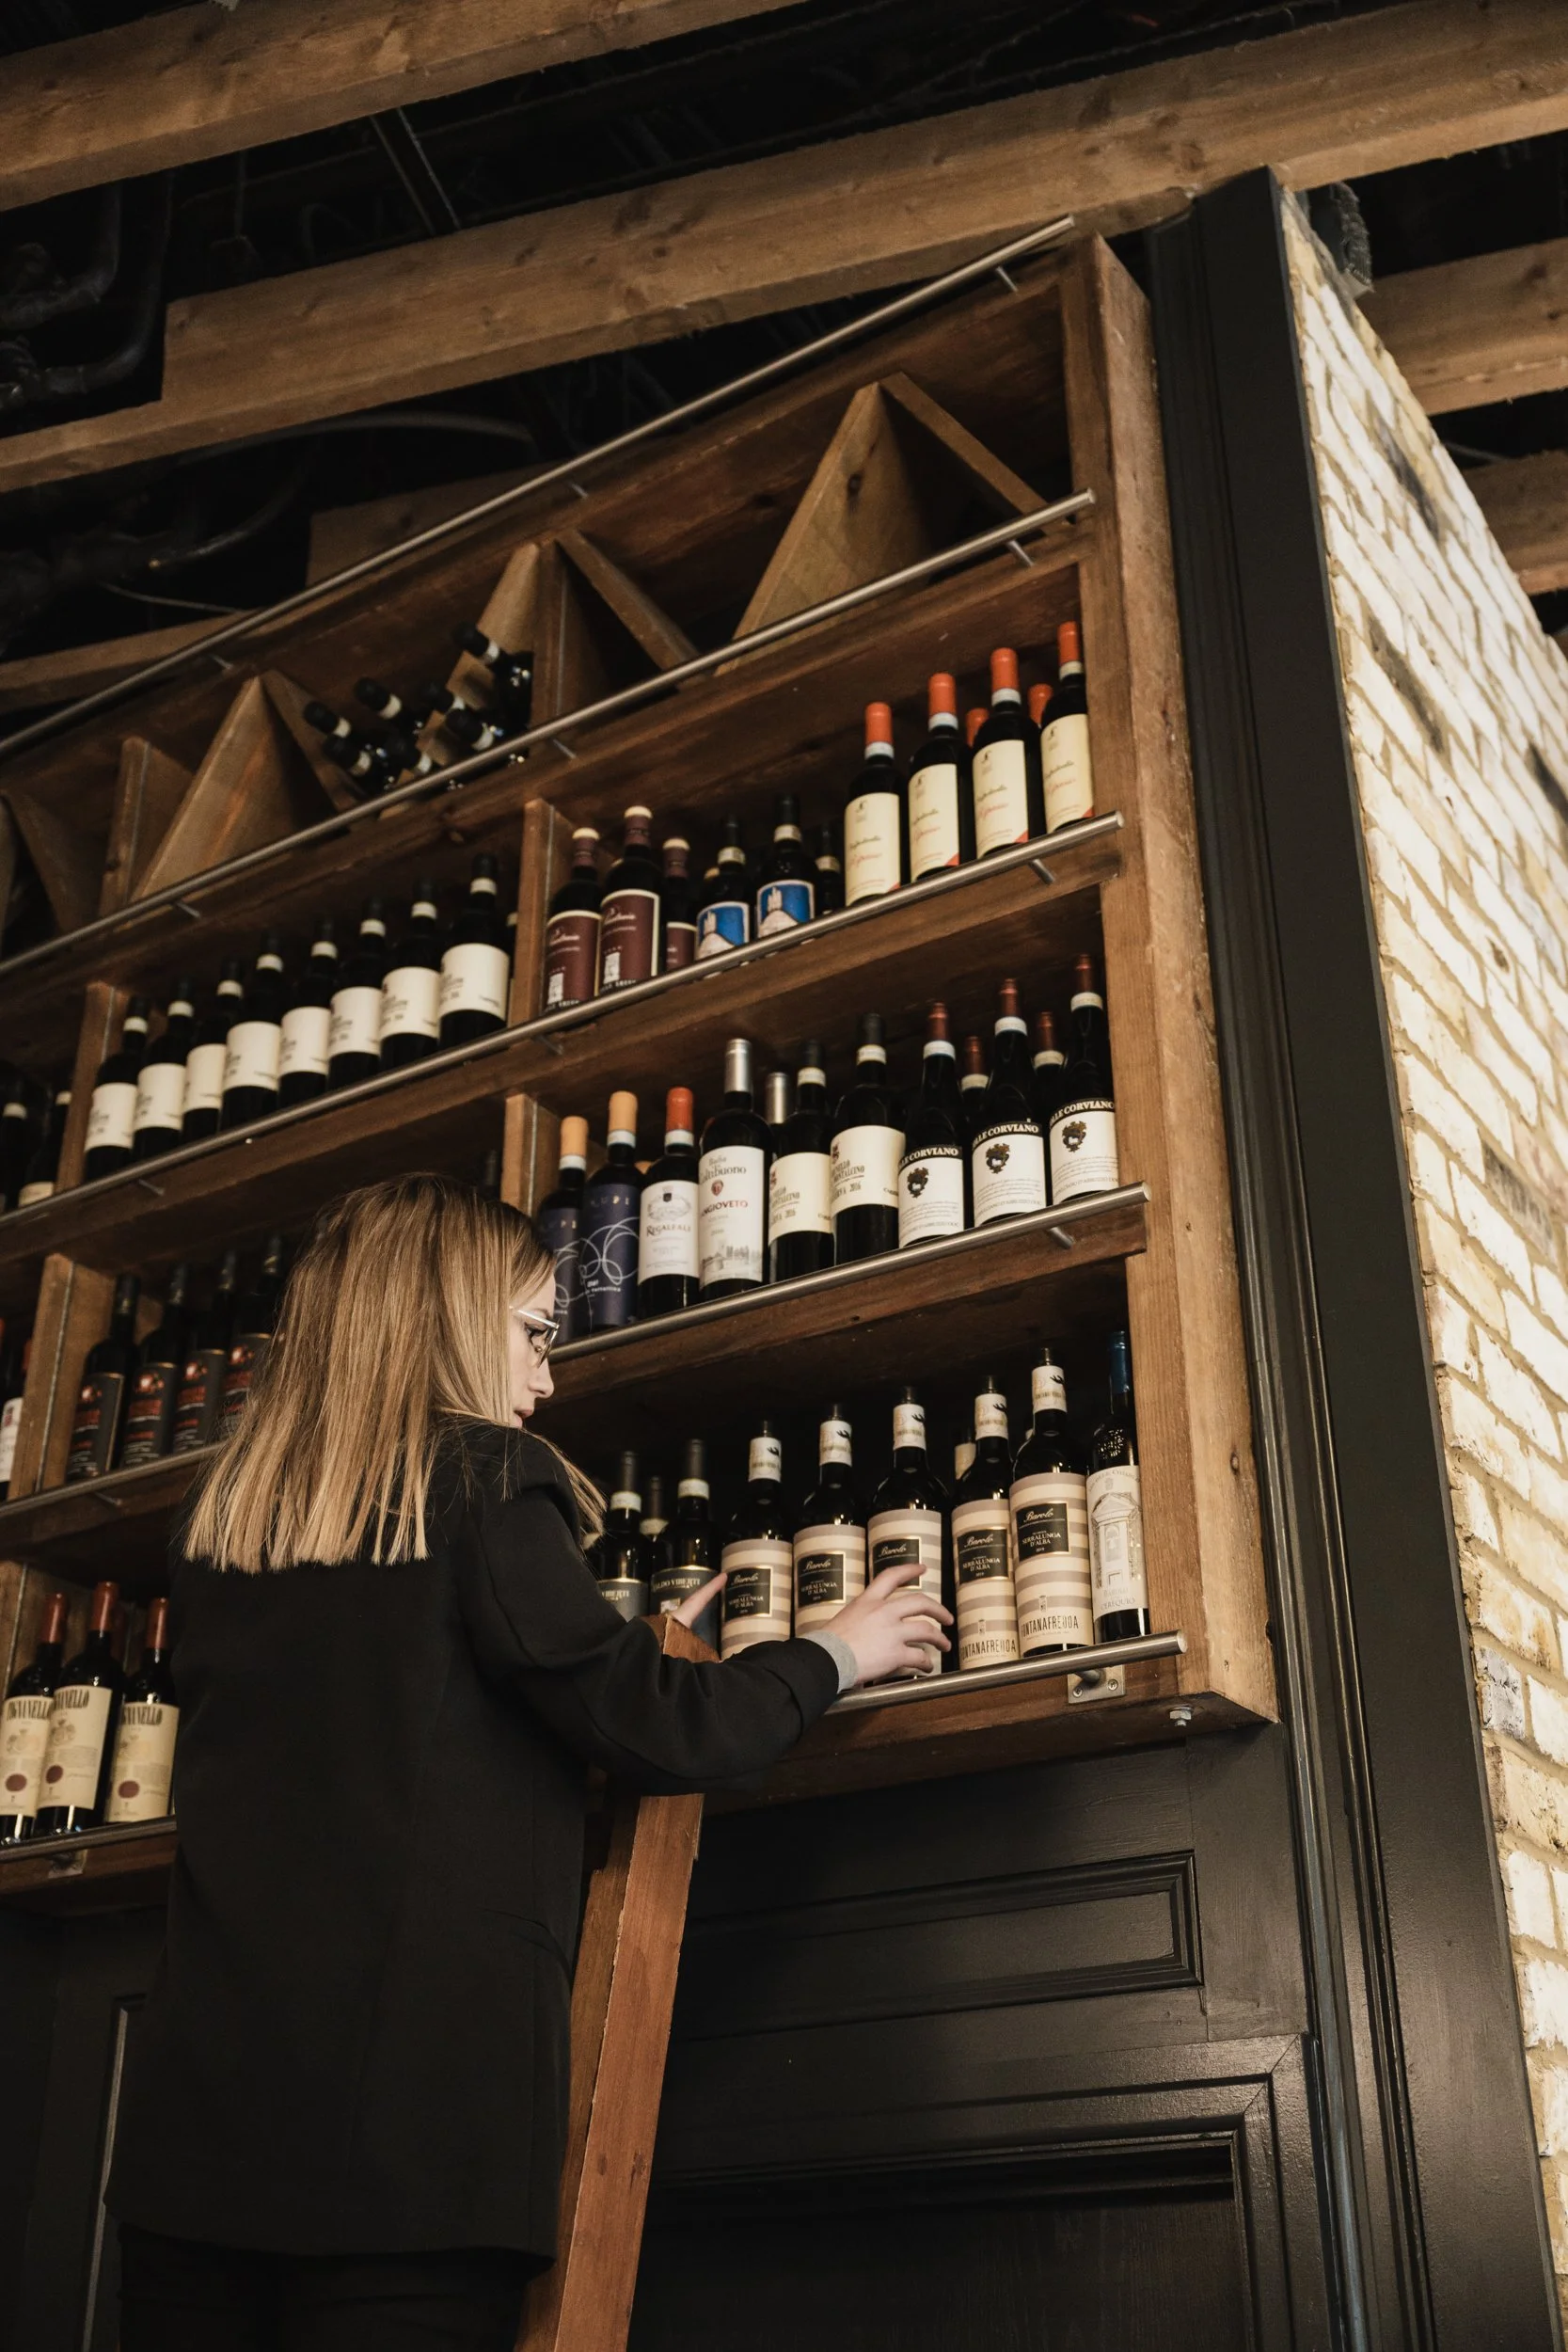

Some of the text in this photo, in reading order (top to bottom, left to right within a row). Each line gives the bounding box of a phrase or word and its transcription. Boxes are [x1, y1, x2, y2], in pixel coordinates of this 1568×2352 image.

[1063, 1100, 1115, 1115] CORVIANO
[988, 1123, 1039, 1136] CORVIANO
[909, 1147, 958, 1161] CORVIANO
[1023, 1507, 1054, 1523] Barolo
